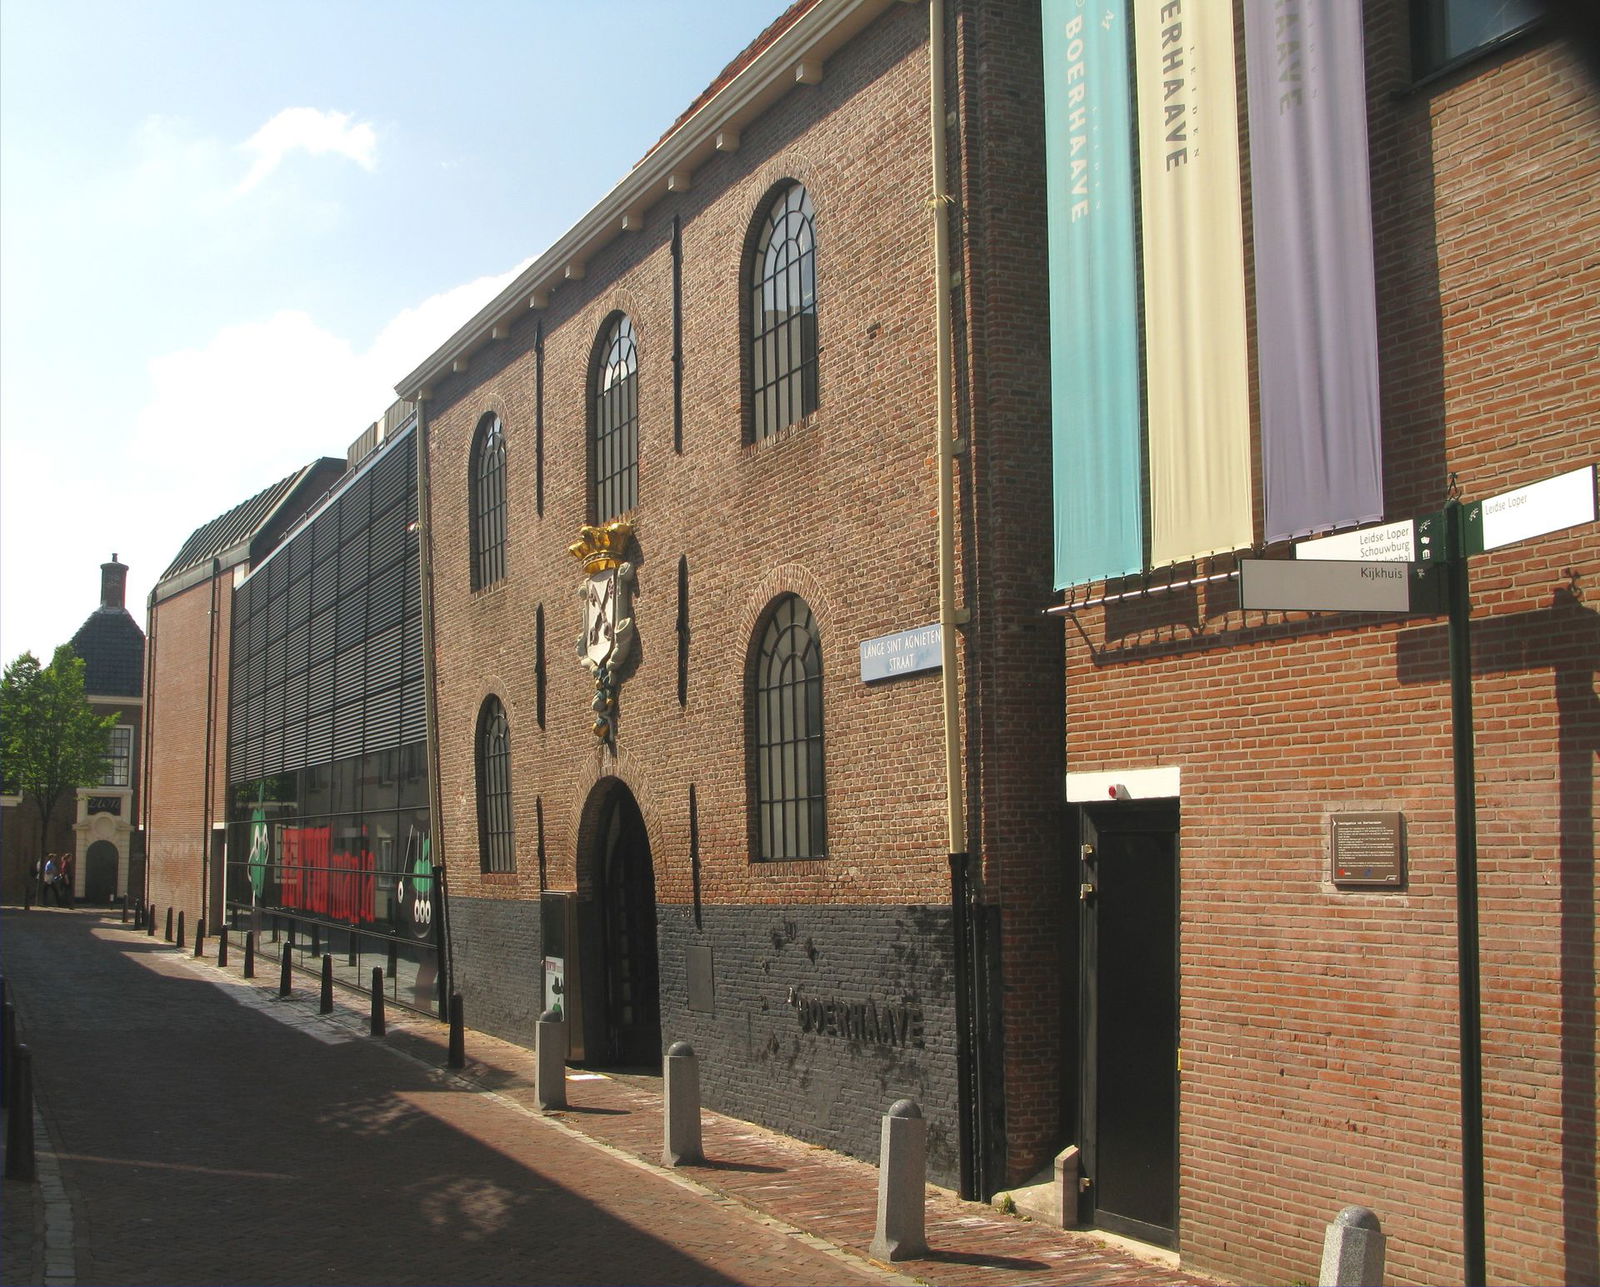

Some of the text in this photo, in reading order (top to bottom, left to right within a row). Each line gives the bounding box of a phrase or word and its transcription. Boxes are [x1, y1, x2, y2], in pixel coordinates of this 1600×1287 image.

[1160, 0, 1188, 172] ERHAAVE
[1190, 45, 1200, 158] LEIDEN
[1065, 15, 1088, 223] BOERHAAVE
[1485, 495, 1527, 515] Leidse Loper
[1360, 528, 1409, 545] Leidse Loper
[1360, 541, 1410, 558] Schouwburg
[1361, 567, 1403, 580] Kijkhuis
[864, 630, 940, 658] LANGE SINT AGNIETEN
[889, 654, 914, 671] STRAAT
